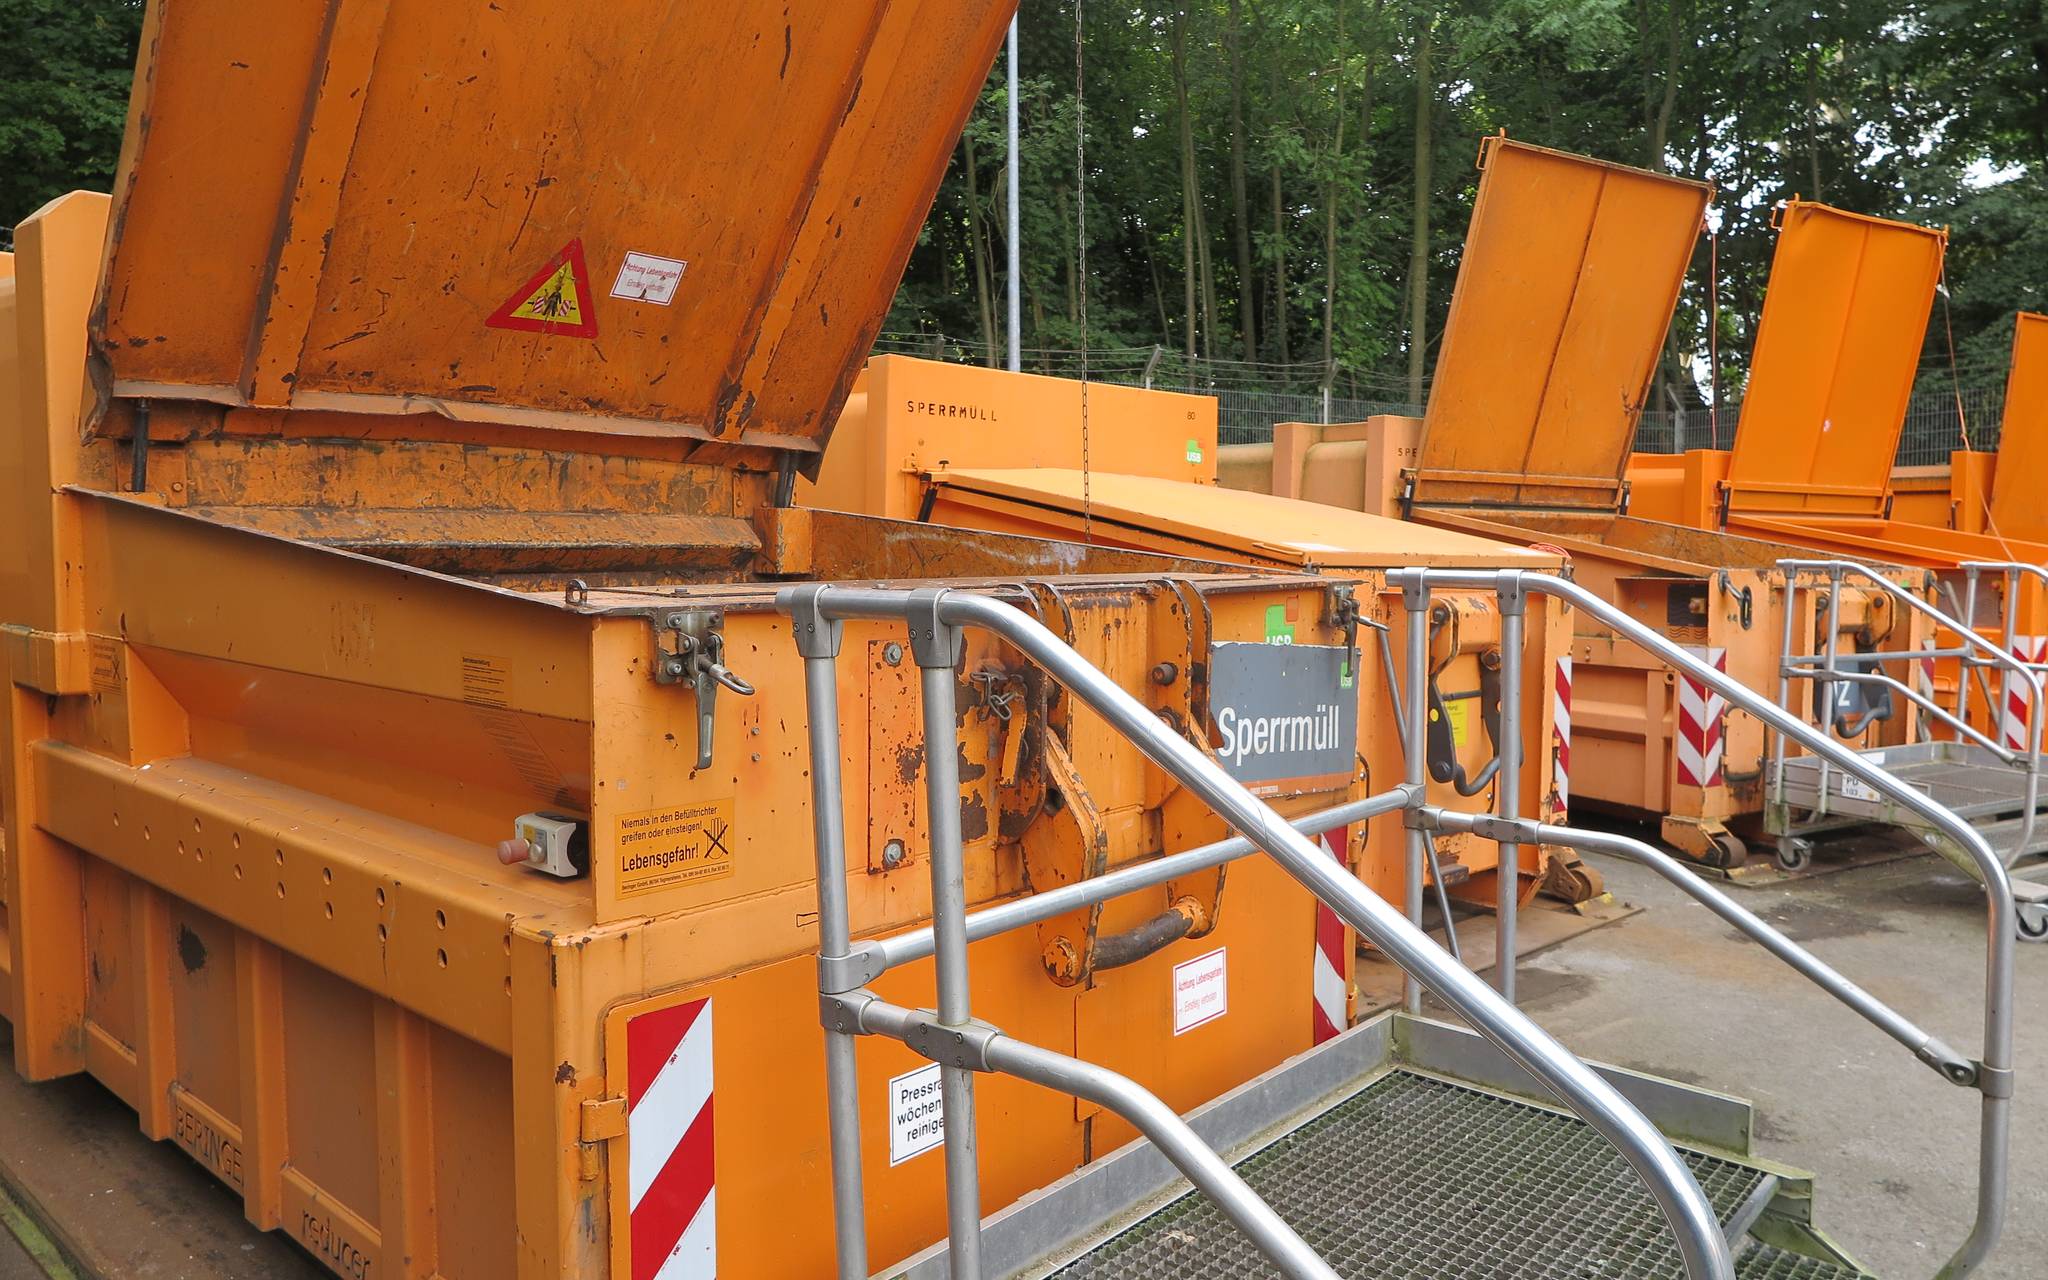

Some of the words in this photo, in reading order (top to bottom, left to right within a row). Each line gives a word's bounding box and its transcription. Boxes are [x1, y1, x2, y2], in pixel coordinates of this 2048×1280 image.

[1218, 704, 1339, 767] Sperrmüll
[621, 816, 650, 830] Niemals
[652, 816, 658, 824] in
[660, 813, 672, 824] den
[674, 807, 718, 820] Befülltrichter
[621, 831, 646, 845] greifen
[648, 828, 664, 839] oder
[665, 821, 702, 836] einsteigen!
[622, 843, 699, 872] Lebensgefahr!
[897, 1099, 942, 1125] wöchen
[907, 1116, 944, 1142] reinige
[176, 1105, 245, 1187] BERINGE
[302, 1208, 371, 1280] reducer
